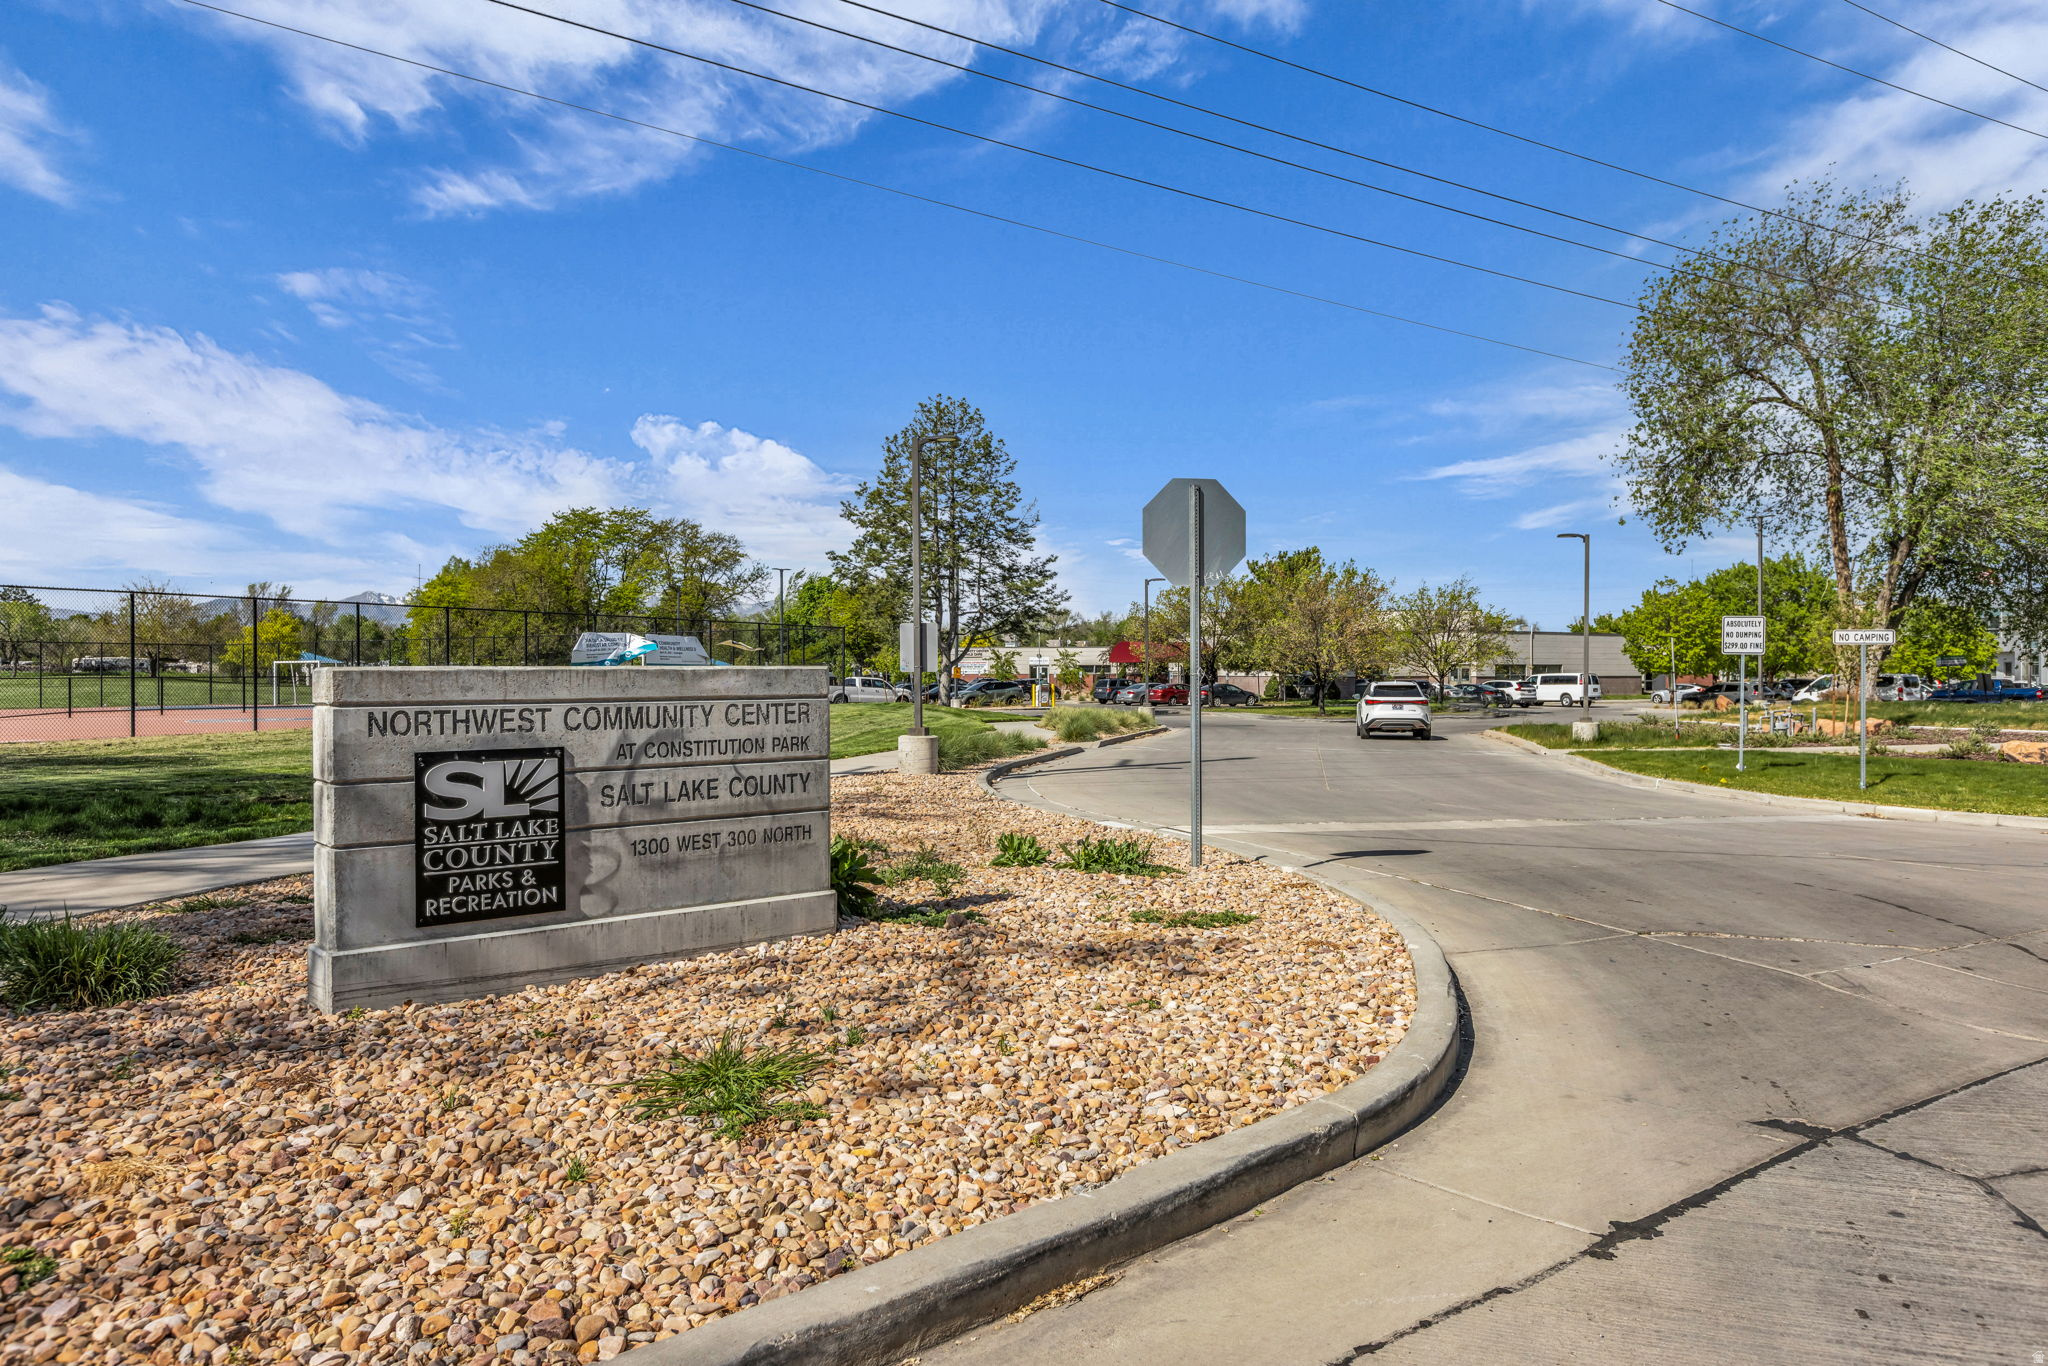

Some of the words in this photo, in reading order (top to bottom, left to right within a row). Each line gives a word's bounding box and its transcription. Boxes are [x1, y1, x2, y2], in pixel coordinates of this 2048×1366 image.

[1725, 631, 1734, 639] NO
[1735, 631, 1762, 639] DUMPING
[1726, 620, 1762, 628] ABSOLUTELY
[1749, 642, 1763, 650] FINE
[1838, 633, 1850, 642] NO
[1853, 633, 1890, 642] CAMPING
[367, 706, 552, 737] NORTHWEST
[563, 704, 714, 732] COMMUNITY
[724, 702, 810, 727] CENTER
[616, 743, 637, 760] AT
[644, 737, 765, 759] CONSTITUTION
[772, 735, 810, 752] PARK
[601, 782, 654, 808] SALT
[664, 778, 719, 803] LAKE
[728, 772, 811, 798] COUNTY
[424, 822, 488, 845] SALT
[495, 818, 559, 839] LAKE
[630, 837, 670, 857] 1300
[676, 832, 721, 852] WEST
[727, 829, 757, 847] 300
[763, 824, 812, 843] NORTH
[423, 839, 560, 871] COUNTY
[448, 871, 514, 893] PARKS
[521, 869, 537, 886] &
[426, 886, 558, 917] RECREATION
